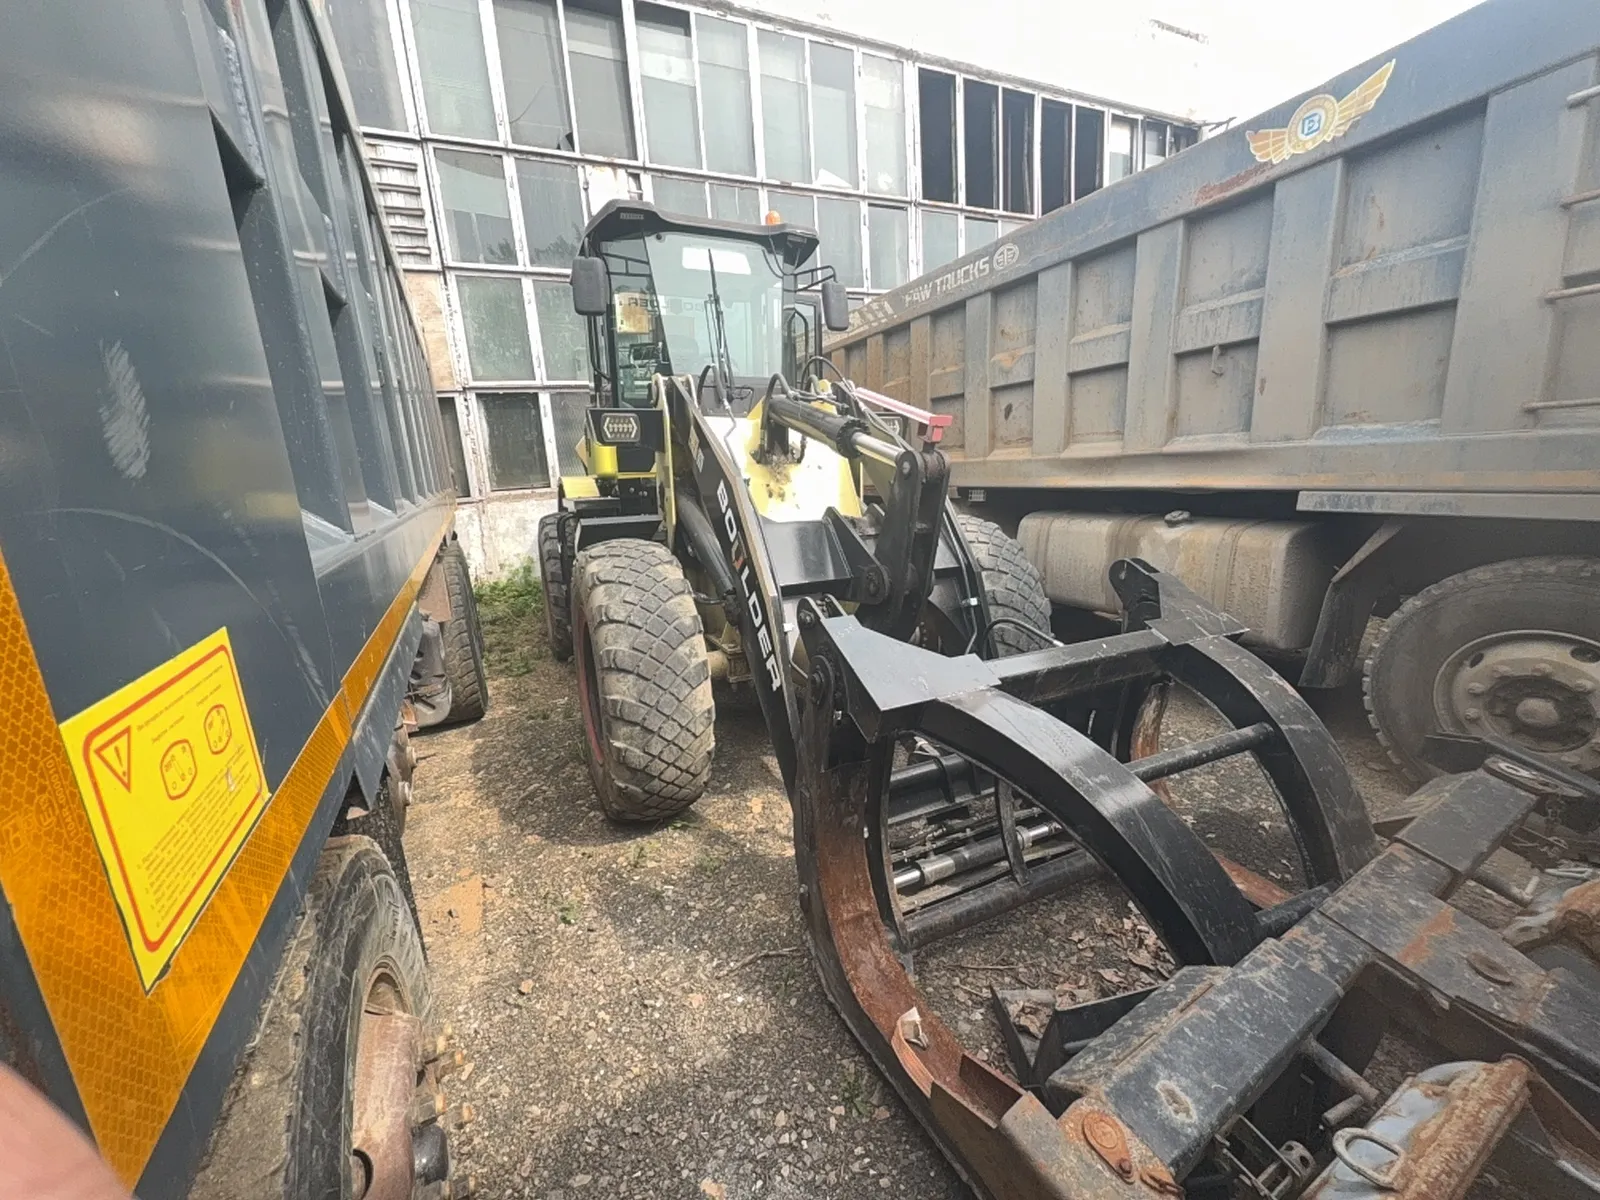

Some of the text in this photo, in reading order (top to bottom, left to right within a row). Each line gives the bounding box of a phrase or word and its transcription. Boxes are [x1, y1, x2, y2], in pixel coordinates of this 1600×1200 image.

[904, 256, 990, 307] FAW TRUCKS
[717, 479, 781, 692] BOULDER
